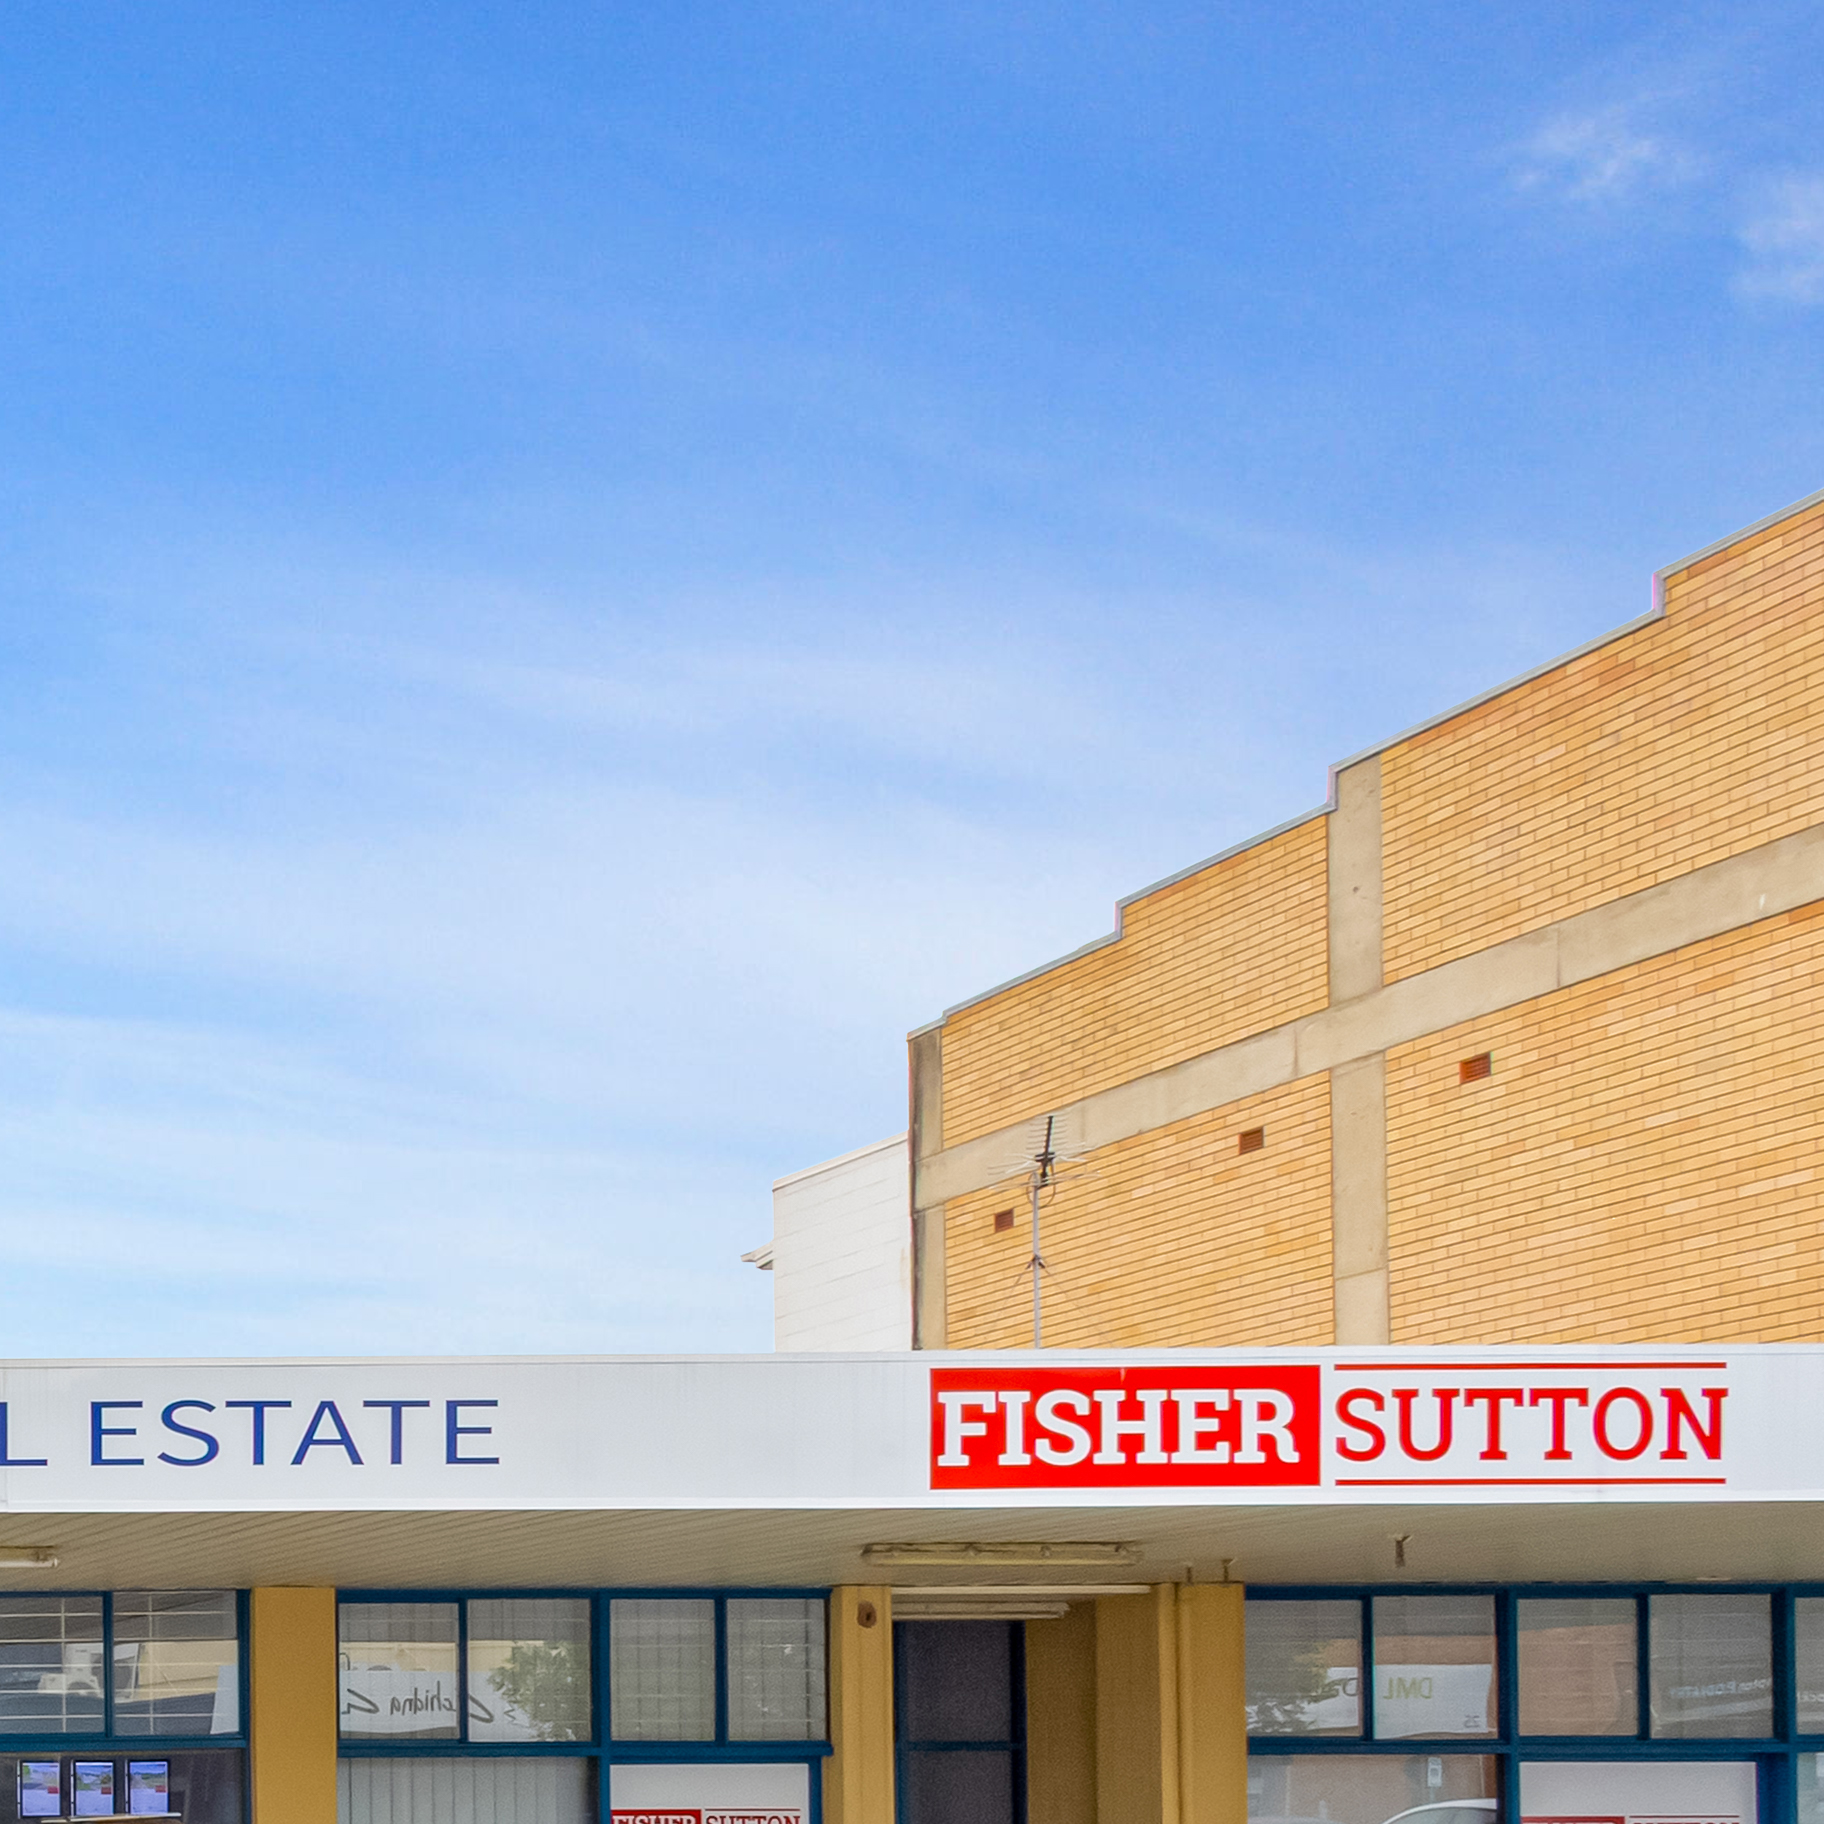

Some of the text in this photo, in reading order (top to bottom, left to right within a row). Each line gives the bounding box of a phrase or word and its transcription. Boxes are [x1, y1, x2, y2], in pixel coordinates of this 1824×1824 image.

[90, 1399, 500, 1467] ESTATE
[936, 1386, 1727, 1466] FISHER SUTTON
